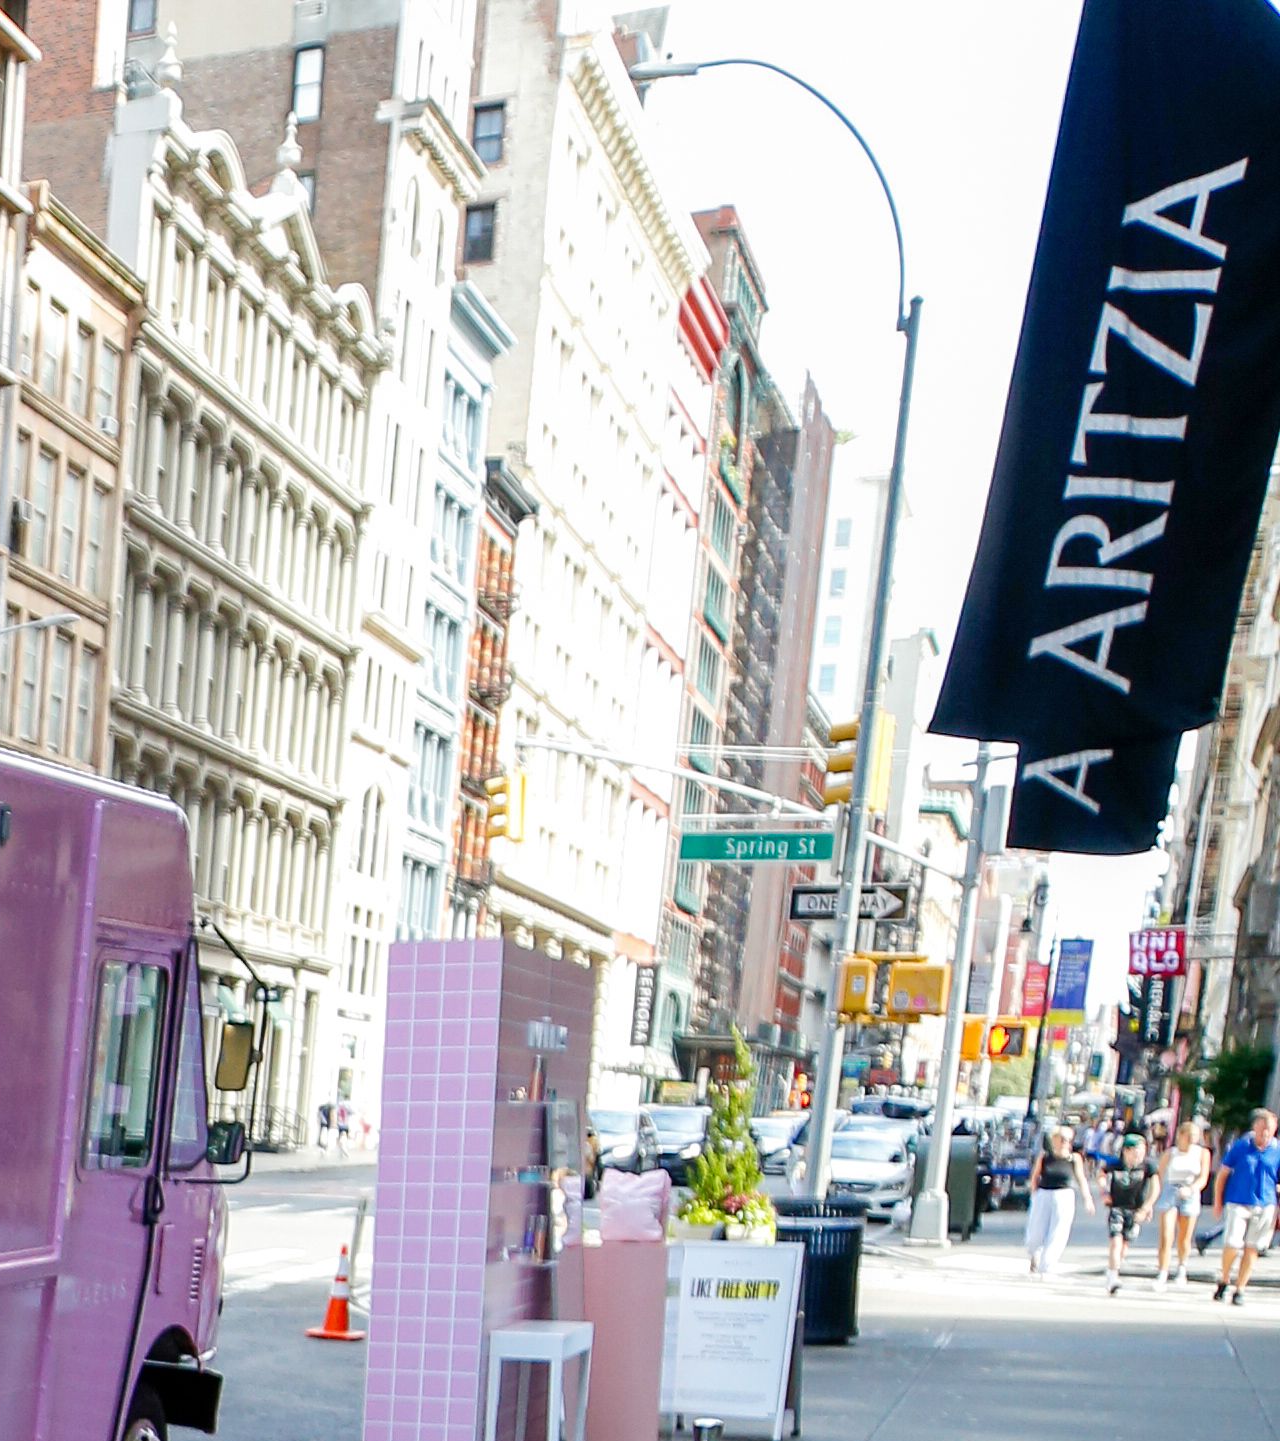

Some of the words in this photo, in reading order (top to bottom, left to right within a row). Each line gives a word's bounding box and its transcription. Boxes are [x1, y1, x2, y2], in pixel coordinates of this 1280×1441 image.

[1028, 157, 1249, 695] ARITZIA
[725, 836, 789, 858] Spring
[798, 837, 816, 855] St
[807, 895, 838, 910] ONE
[1132, 931, 1177, 951] UNI
[1132, 951, 1180, 974] QLO
[633, 967, 654, 1044] SEPHORA
[690, 1277, 713, 1299] LIKE
[716, 1278, 741, 1300] FREE
